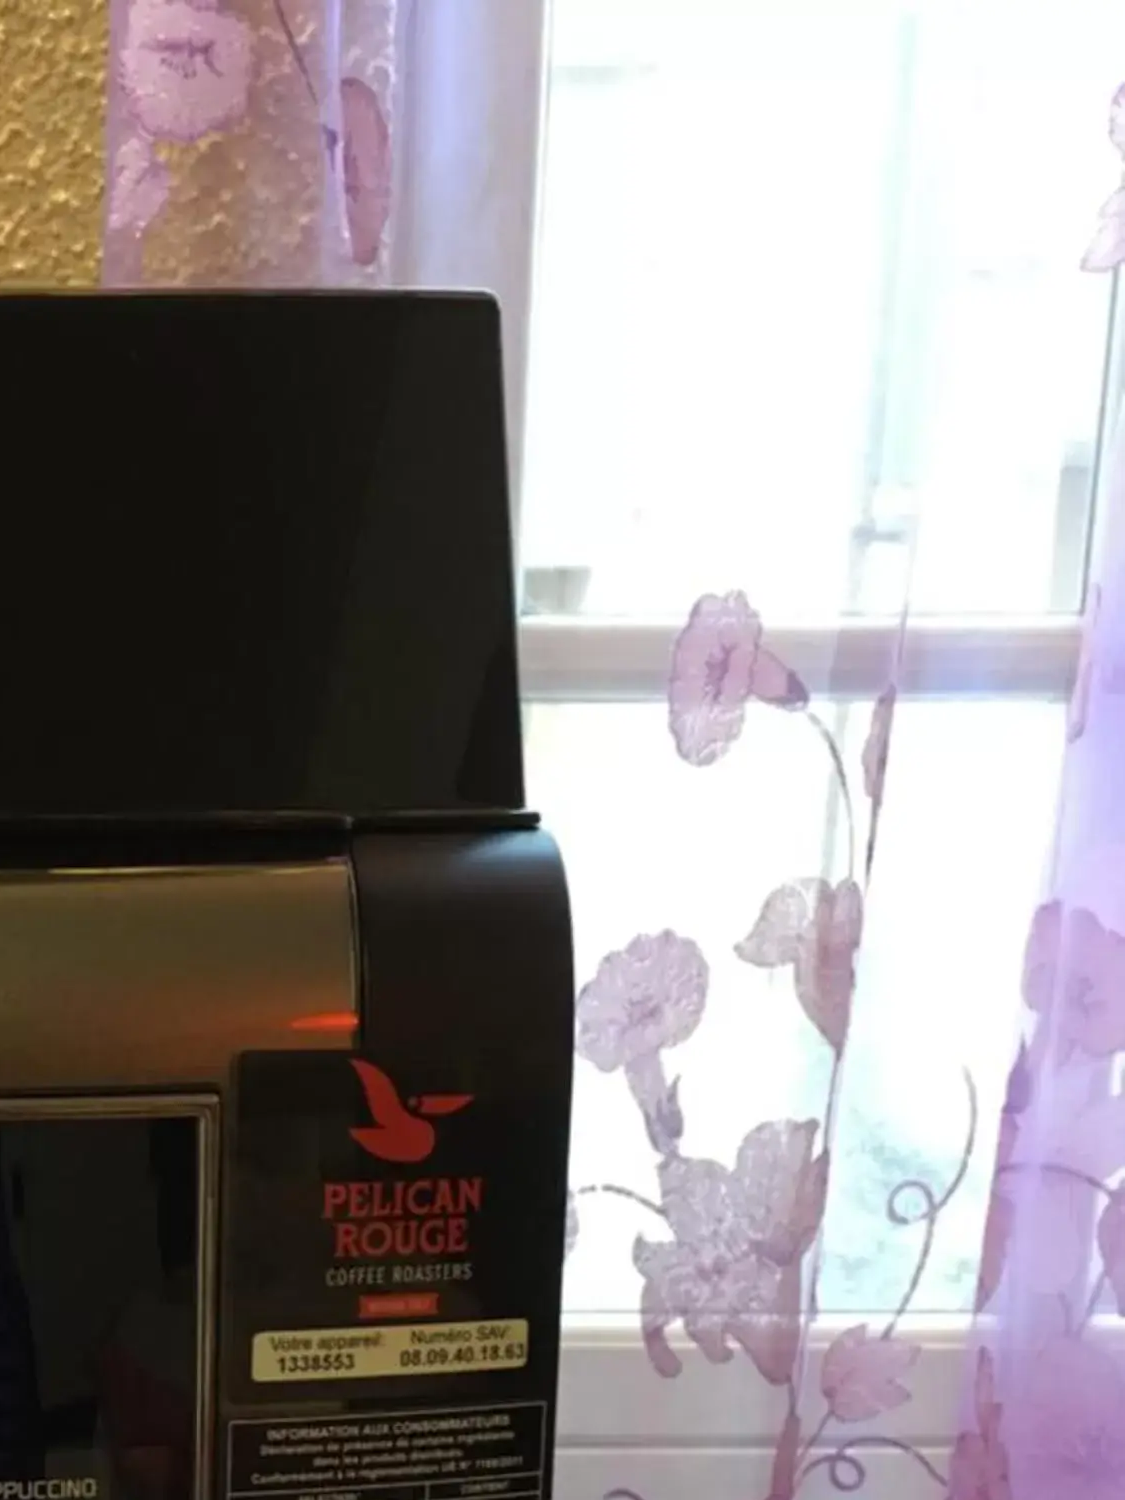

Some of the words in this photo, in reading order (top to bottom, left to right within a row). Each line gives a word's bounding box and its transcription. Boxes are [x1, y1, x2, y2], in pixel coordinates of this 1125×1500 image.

[322, 1176, 483, 1219] PELICAN
[334, 1218, 469, 1258] ROUGE
[325, 1265, 385, 1286] COFFEE
[392, 1262, 474, 1283] ROASTERS
[269, 1336, 313, 1352] Votre
[410, 1328, 473, 1345] Numéro
[278, 1353, 356, 1373] 1338553
